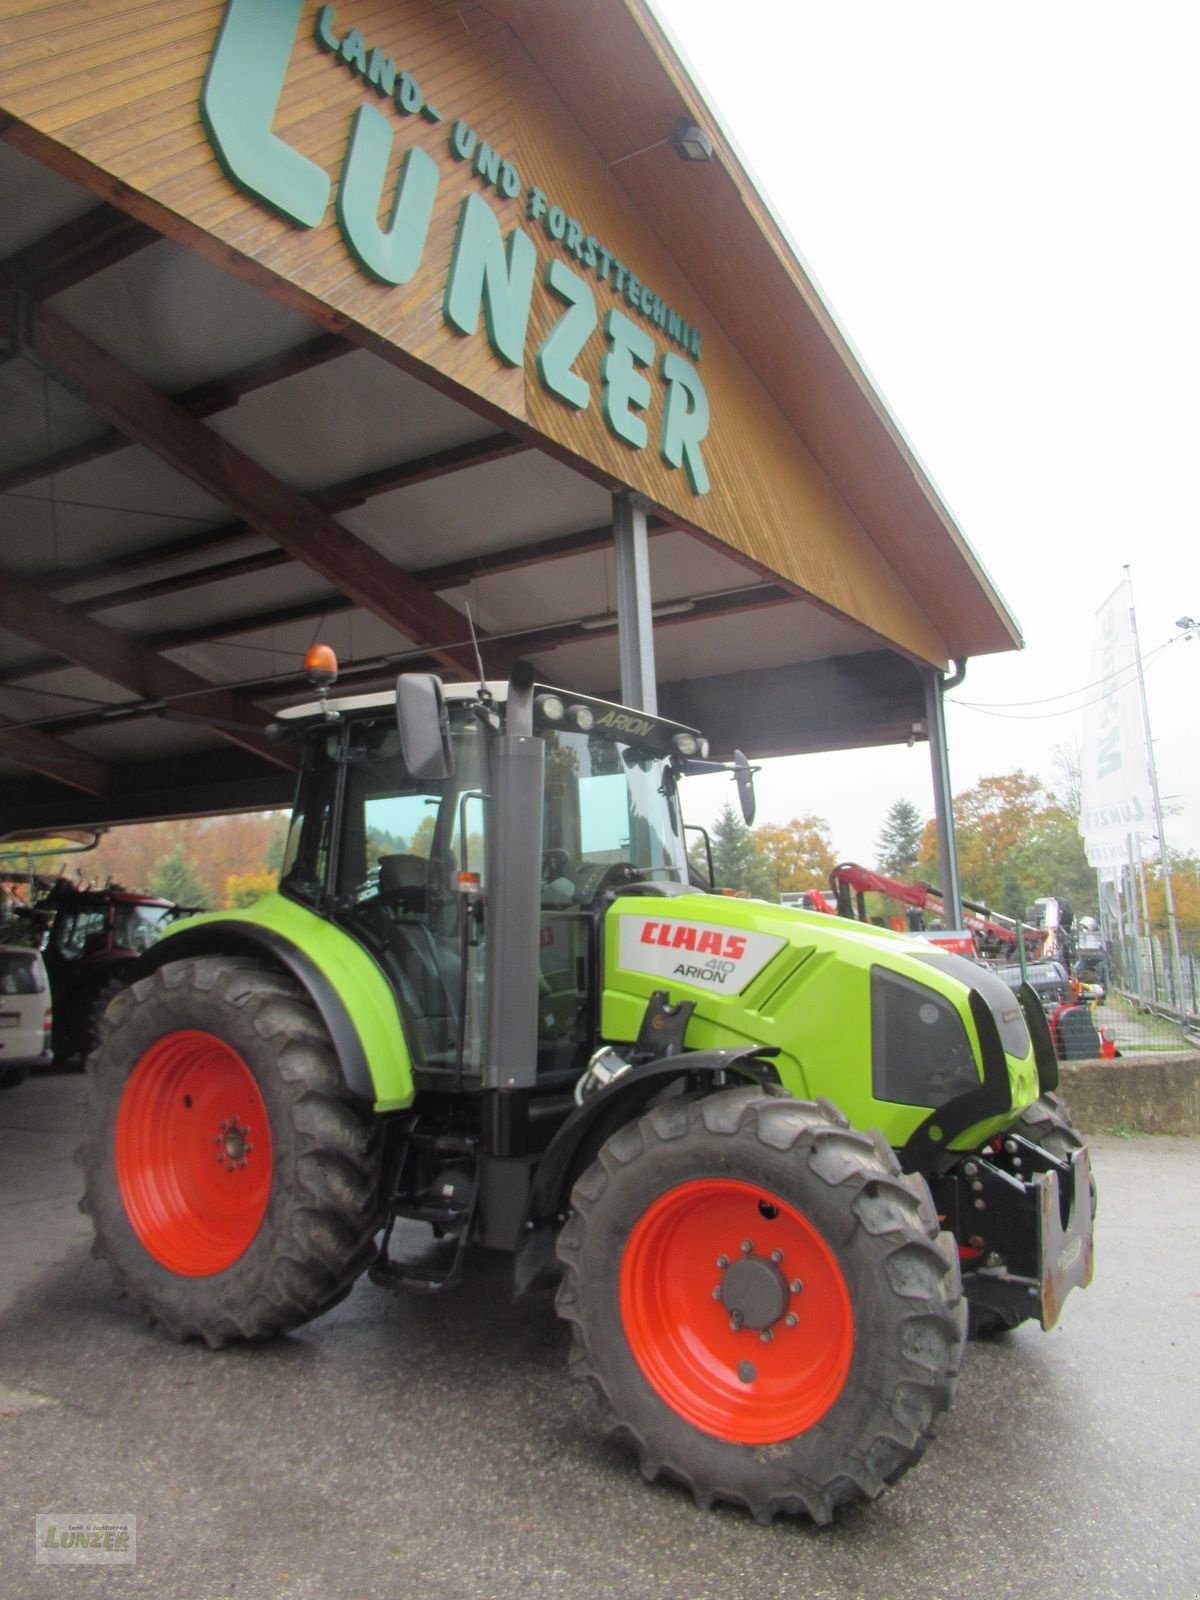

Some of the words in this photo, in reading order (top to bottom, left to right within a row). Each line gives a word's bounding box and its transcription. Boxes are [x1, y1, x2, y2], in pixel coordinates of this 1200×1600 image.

[314, 3, 443, 124] LAND-
[449, 119, 521, 200] UND
[526, 186, 704, 362] FORSTTECHNIK
[199, 0, 711, 496] LUNZER
[596, 710, 656, 738] ARION
[640, 921, 748, 960] CLAAS
[673, 963, 728, 984] ARION
[704, 958, 736, 974] 410
